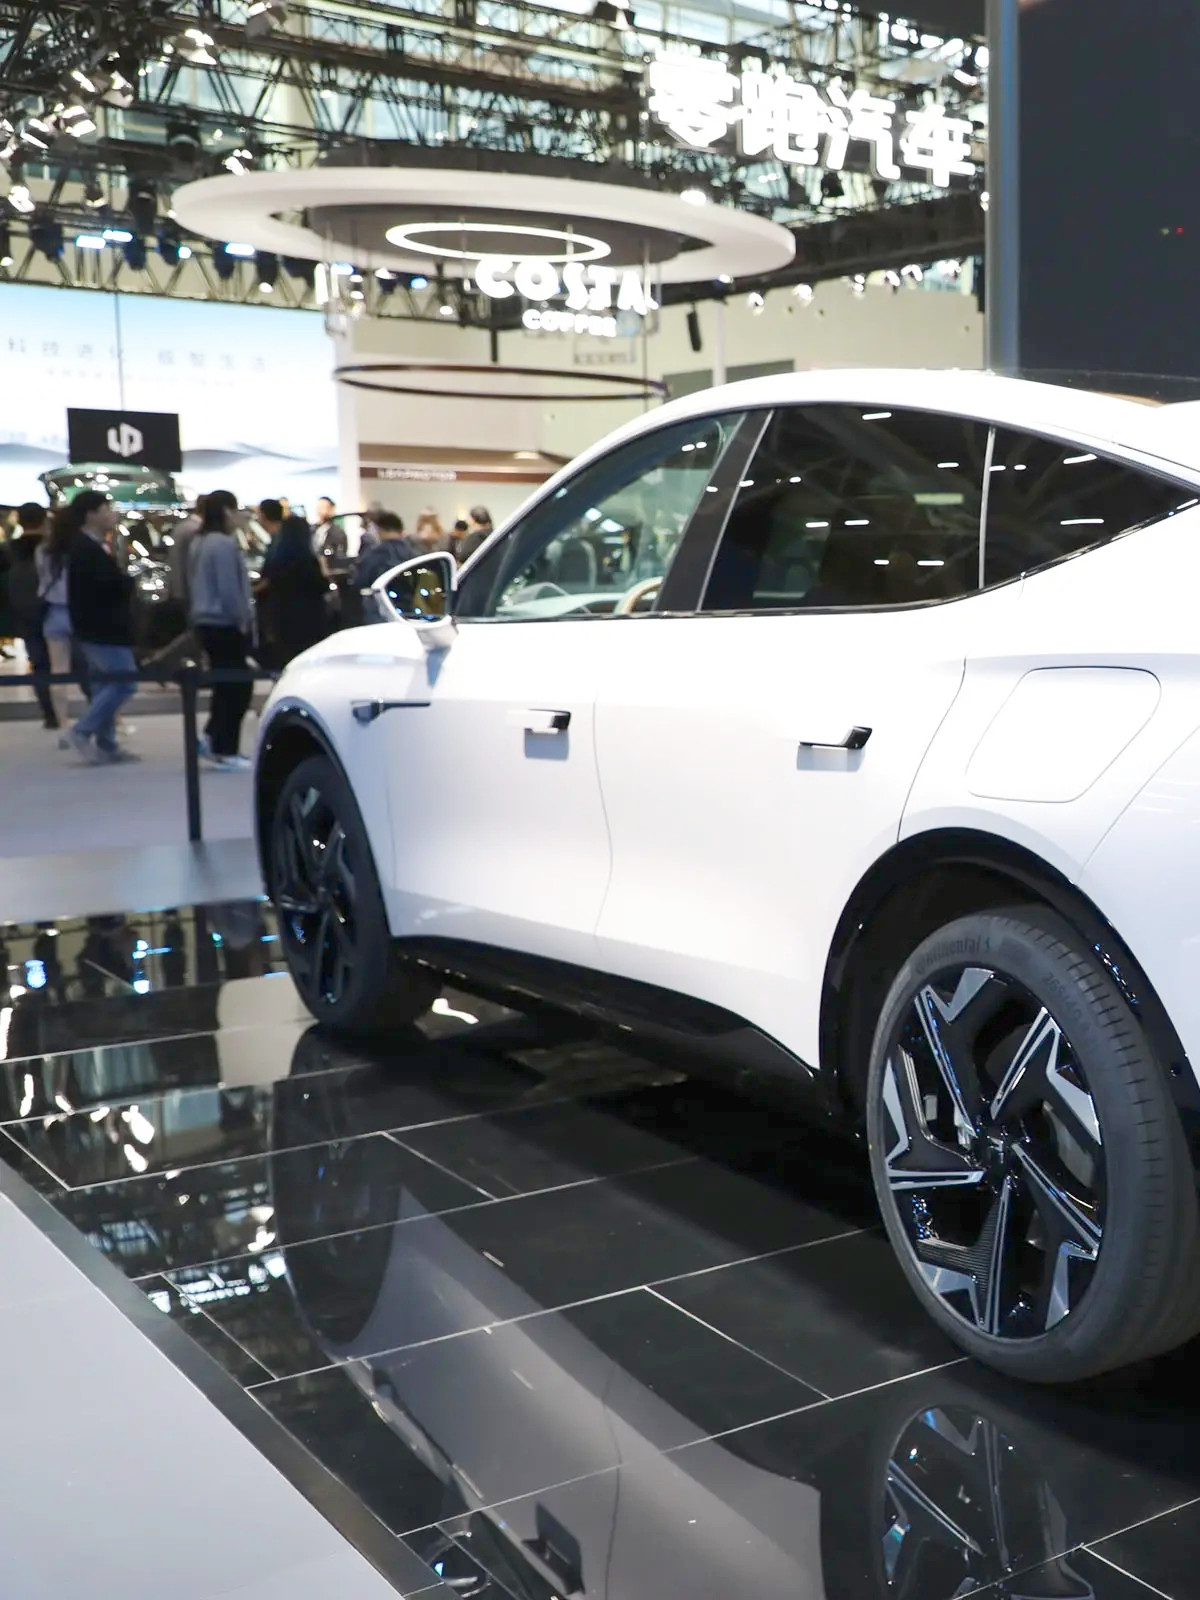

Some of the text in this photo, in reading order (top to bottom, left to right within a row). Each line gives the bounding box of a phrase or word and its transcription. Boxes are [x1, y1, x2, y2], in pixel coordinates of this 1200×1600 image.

[649, 49, 976, 187] 零跑汽车
[475, 258, 656, 315] COSTA
